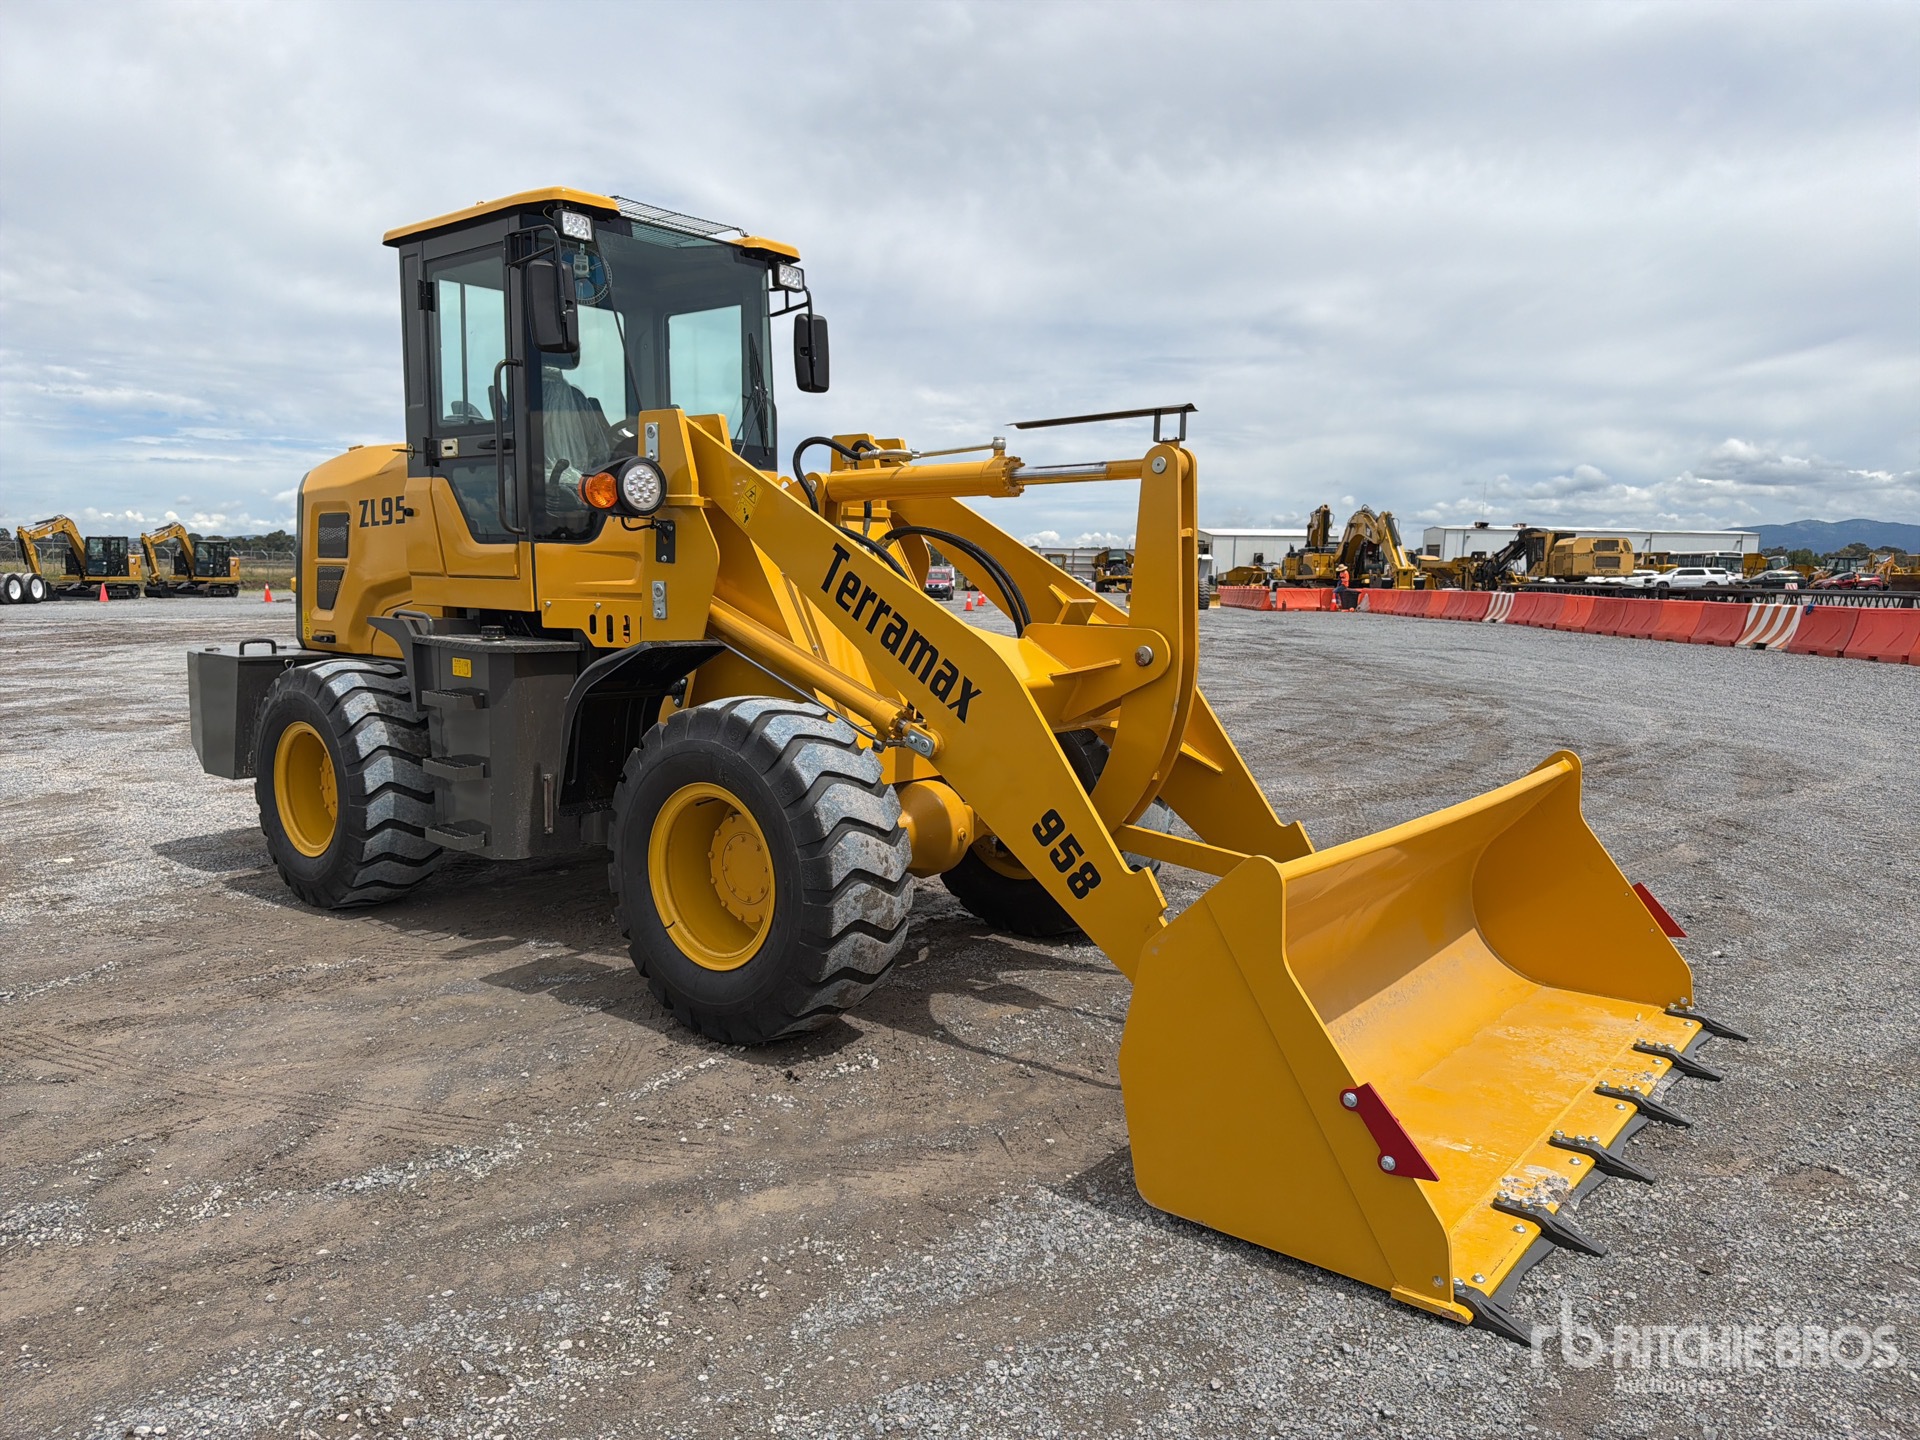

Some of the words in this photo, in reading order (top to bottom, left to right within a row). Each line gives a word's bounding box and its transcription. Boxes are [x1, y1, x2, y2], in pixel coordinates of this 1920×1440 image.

[358, 495, 406, 528] ZL95
[820, 542, 983, 725] Terramax
[1031, 807, 1103, 900] 958
